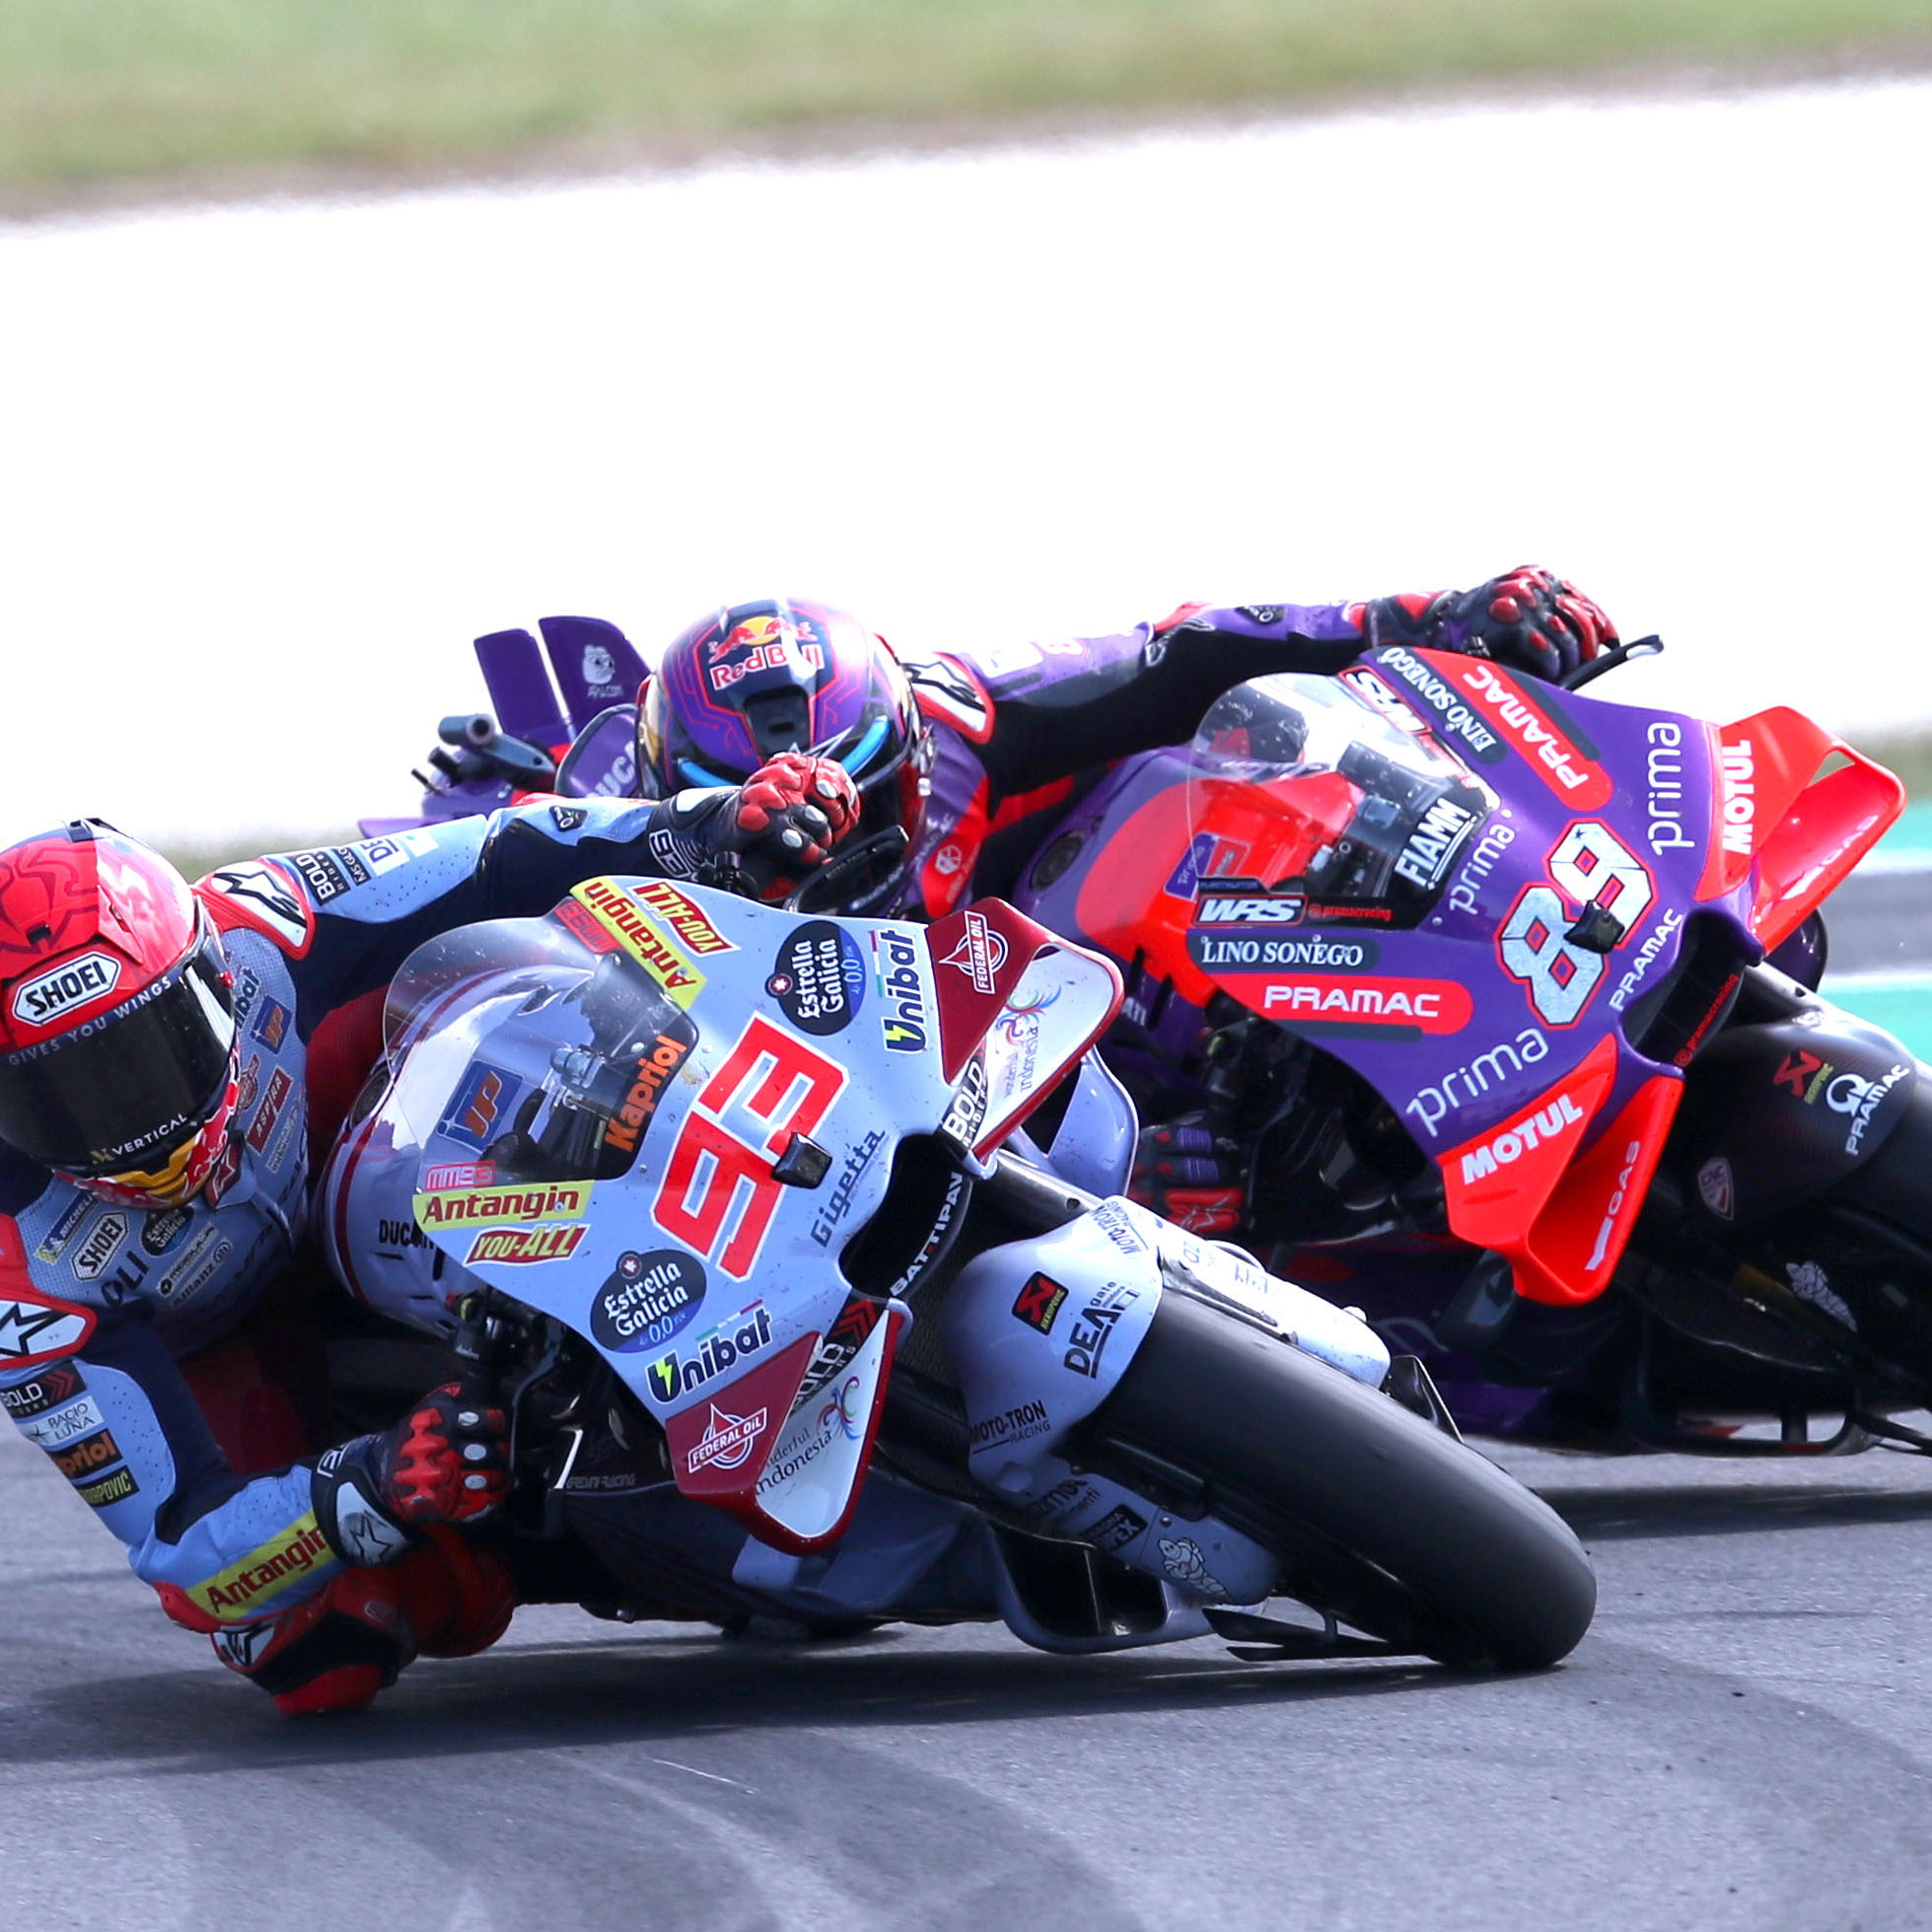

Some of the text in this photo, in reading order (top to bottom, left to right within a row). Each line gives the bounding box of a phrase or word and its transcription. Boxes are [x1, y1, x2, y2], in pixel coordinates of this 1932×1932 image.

[712, 652, 763, 690] Red
[1345, 671, 1429, 733] WRS
[1443, 704, 1499, 754] LINO
[1463, 665, 1589, 790] PRAMAC
[1648, 722, 1695, 855] prima
[1722, 740, 1755, 855] MOTUL
[295, 854, 336, 900] BOLD
[1394, 797, 1471, 888] FIAMM
[1449, 822, 1517, 916] prima
[583, 881, 698, 989] Antangin
[1198, 897, 1304, 922] WRS
[1497, 823, 1652, 1024] 89
[25, 960, 109, 1017] SHOEI
[792, 939, 821, 1020] Estrella
[818, 938, 845, 1014] Galicia
[882, 929, 927, 1052] Unibat
[973, 939, 993, 990] FEDERAL
[1201, 941, 1364, 966] LINO SONEGO
[1609, 908, 1683, 1011] PRAMAC
[8, 974, 174, 1067] GIVES YOU WINGS
[1263, 985, 1441, 1017] PRAMAC
[605, 1035, 689, 1154] Kapriol
[942, 1060, 984, 1137] BOLD
[1405, 1028, 1550, 1137] prima
[1845, 1064, 1911, 1157] PRAMAC
[110, 1111, 188, 1156] VERTICAL
[651, 1011, 850, 1282] 93
[1462, 1093, 1584, 1185] MOTUL
[422, 1185, 580, 1225] Antangin
[811, 1128, 887, 1248] Gigetta
[79, 1217, 123, 1273] SHOEI
[890, 1171, 966, 1297] BATTIPAV
[604, 1258, 682, 1321] Estrella
[614, 1285, 689, 1337] Galicia
[645, 1308, 773, 1404] Unibat
[797, 1342, 845, 1406] OLD
[690, 1425, 742, 1467] FEDERAL
[970, 1399, 1046, 1444] MOTO-TRON
